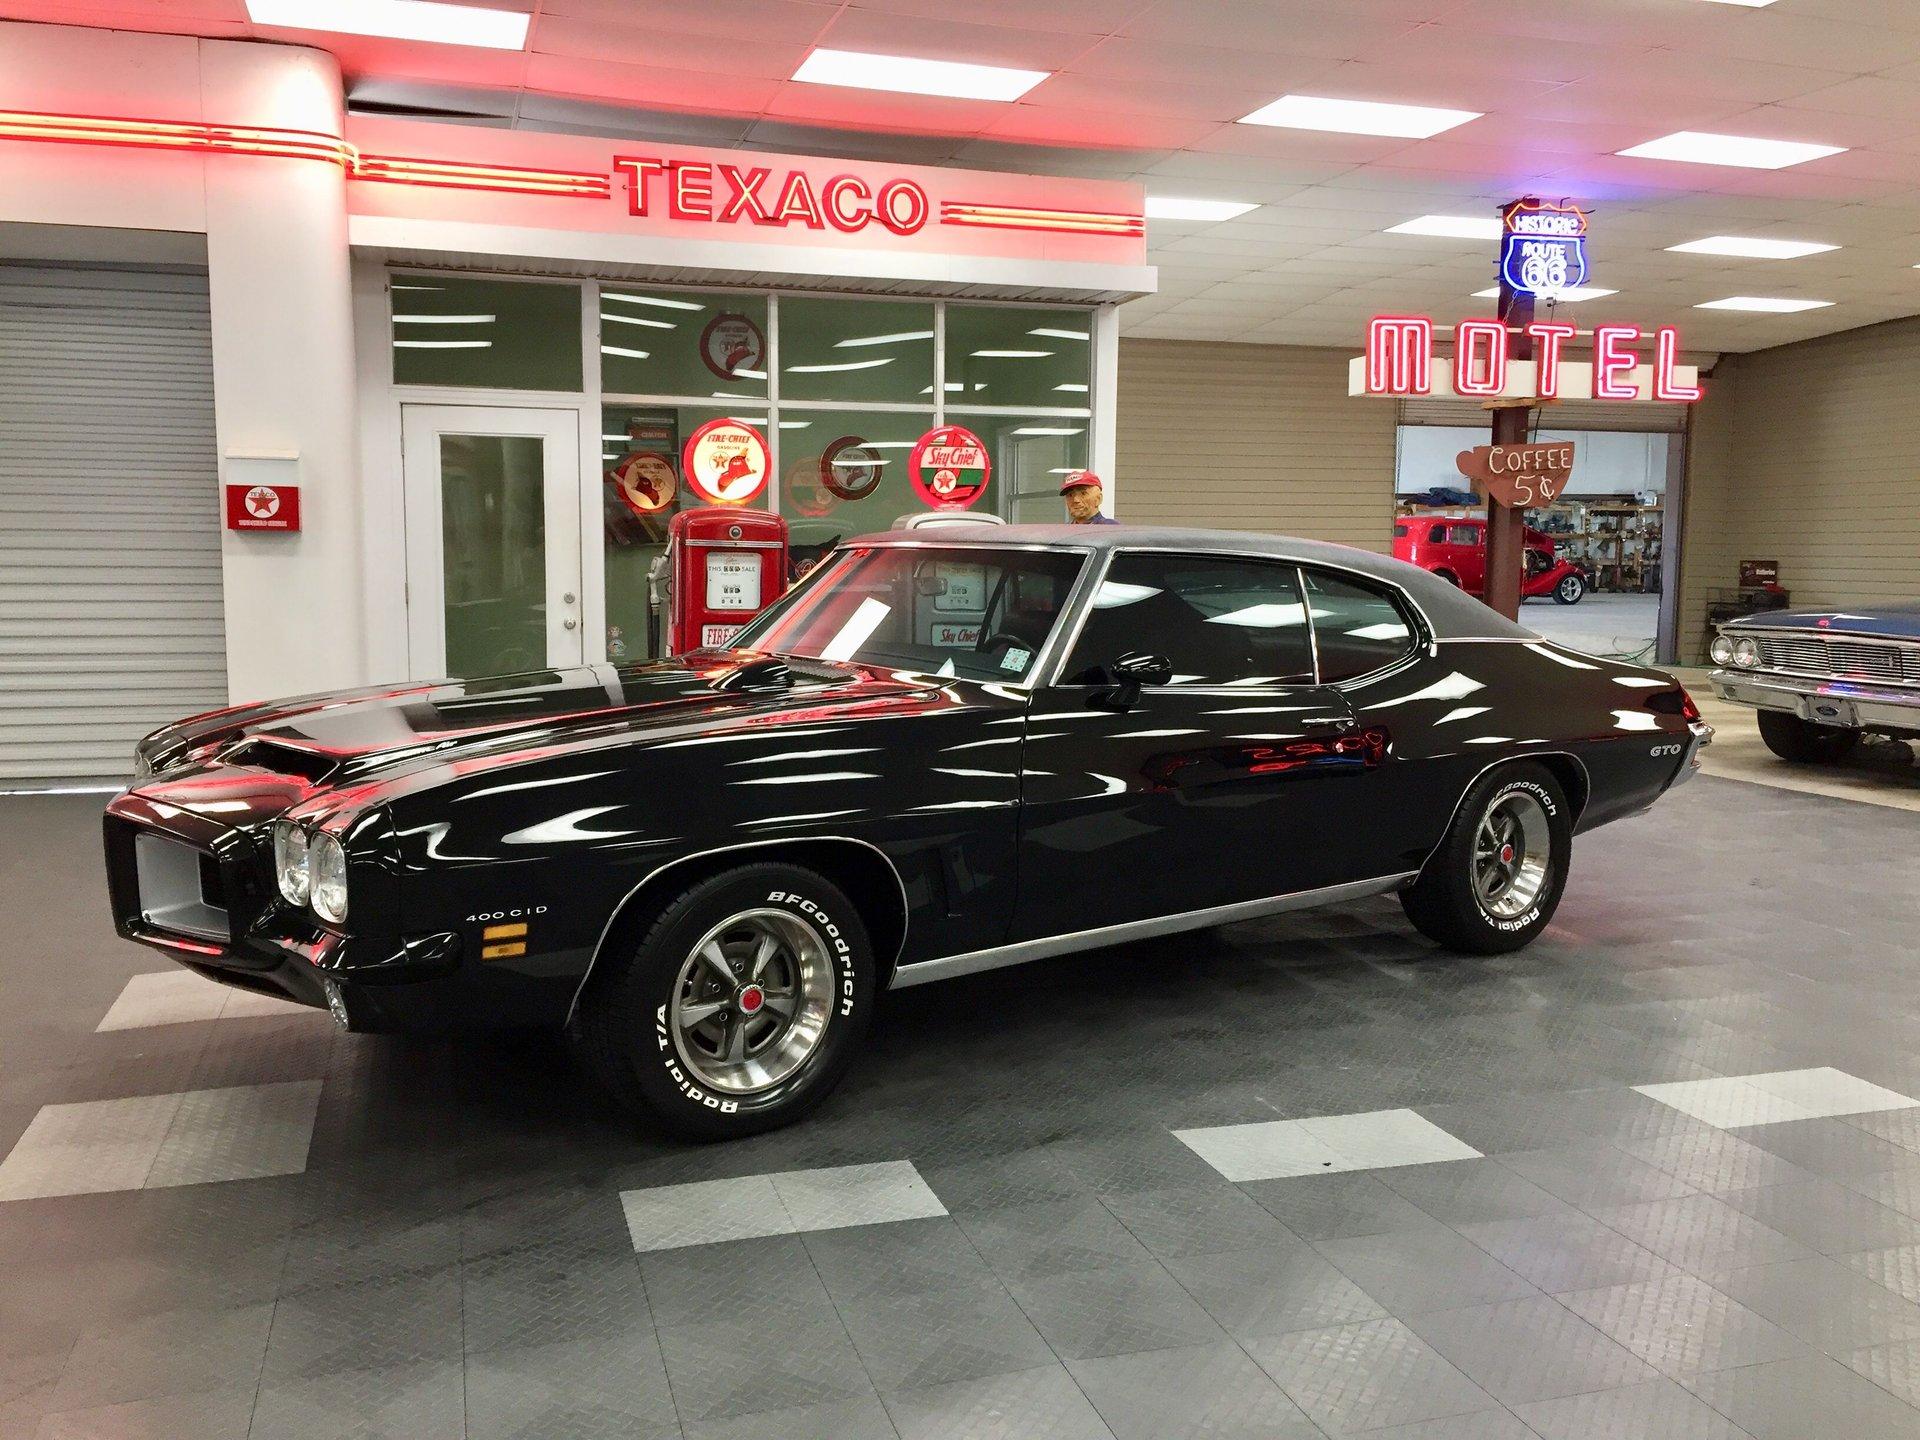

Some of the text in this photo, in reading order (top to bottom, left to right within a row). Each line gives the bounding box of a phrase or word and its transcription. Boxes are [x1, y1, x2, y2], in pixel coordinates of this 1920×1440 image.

[614, 155, 929, 236] TEXACO
[1514, 215, 1579, 235] HISTORIC
[1521, 241, 1567, 258] ROUTE
[1521, 255, 1568, 289] 66
[1365, 314, 1703, 402] MOTEL
[707, 434, 751, 444] FIRE-CHIEF
[928, 446, 978, 467] Sky Chief
[1488, 445, 1572, 474] COFFEE
[1512, 475, 1556, 506] 5¢
[708, 565, 722, 573] THIS
[741, 565, 756, 573] SALE
[940, 628, 981, 644] Sky Chief
[1649, 743, 1682, 758] GTO
[465, 905, 548, 922] 400 CID
[1498, 907, 1541, 932] Radial
[766, 890, 857, 1016] BFGoodrich
[654, 1003, 740, 1115] Radial T/A
